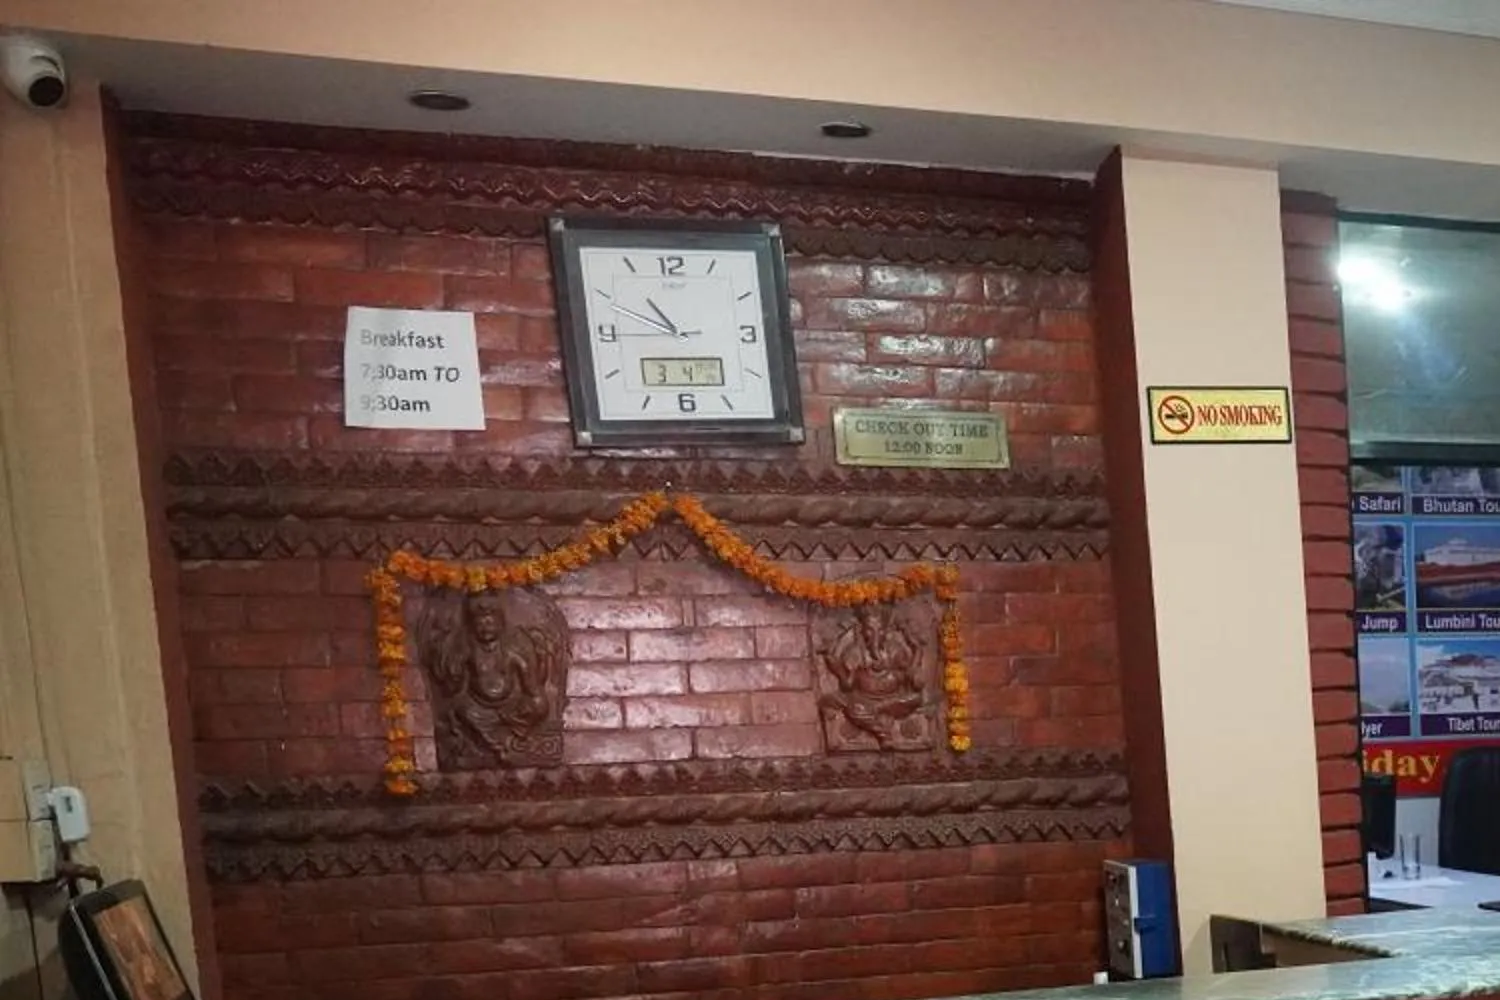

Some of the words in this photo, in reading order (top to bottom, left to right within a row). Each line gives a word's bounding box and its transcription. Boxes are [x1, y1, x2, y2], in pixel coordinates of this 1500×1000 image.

[657, 256, 686, 276] 12
[360, 329, 446, 349] Breakfast
[739, 325, 757, 344] 3
[434, 366, 460, 382] TO
[677, 393, 696, 413] 6
[1197, 405, 1218, 426] NO
[1219, 405, 1282, 427] SMOKING
[855, 420, 909, 435] CHECK
[912, 423, 944, 437] OUT
[950, 424, 989, 438] TIME
[1359, 496, 1401, 512] Safari
[1423, 498, 1474, 513] Bhutan
[1361, 615, 1399, 632] Jump
[1425, 613, 1476, 629] Lumbini
[1446, 716, 1476, 731] Tibet
